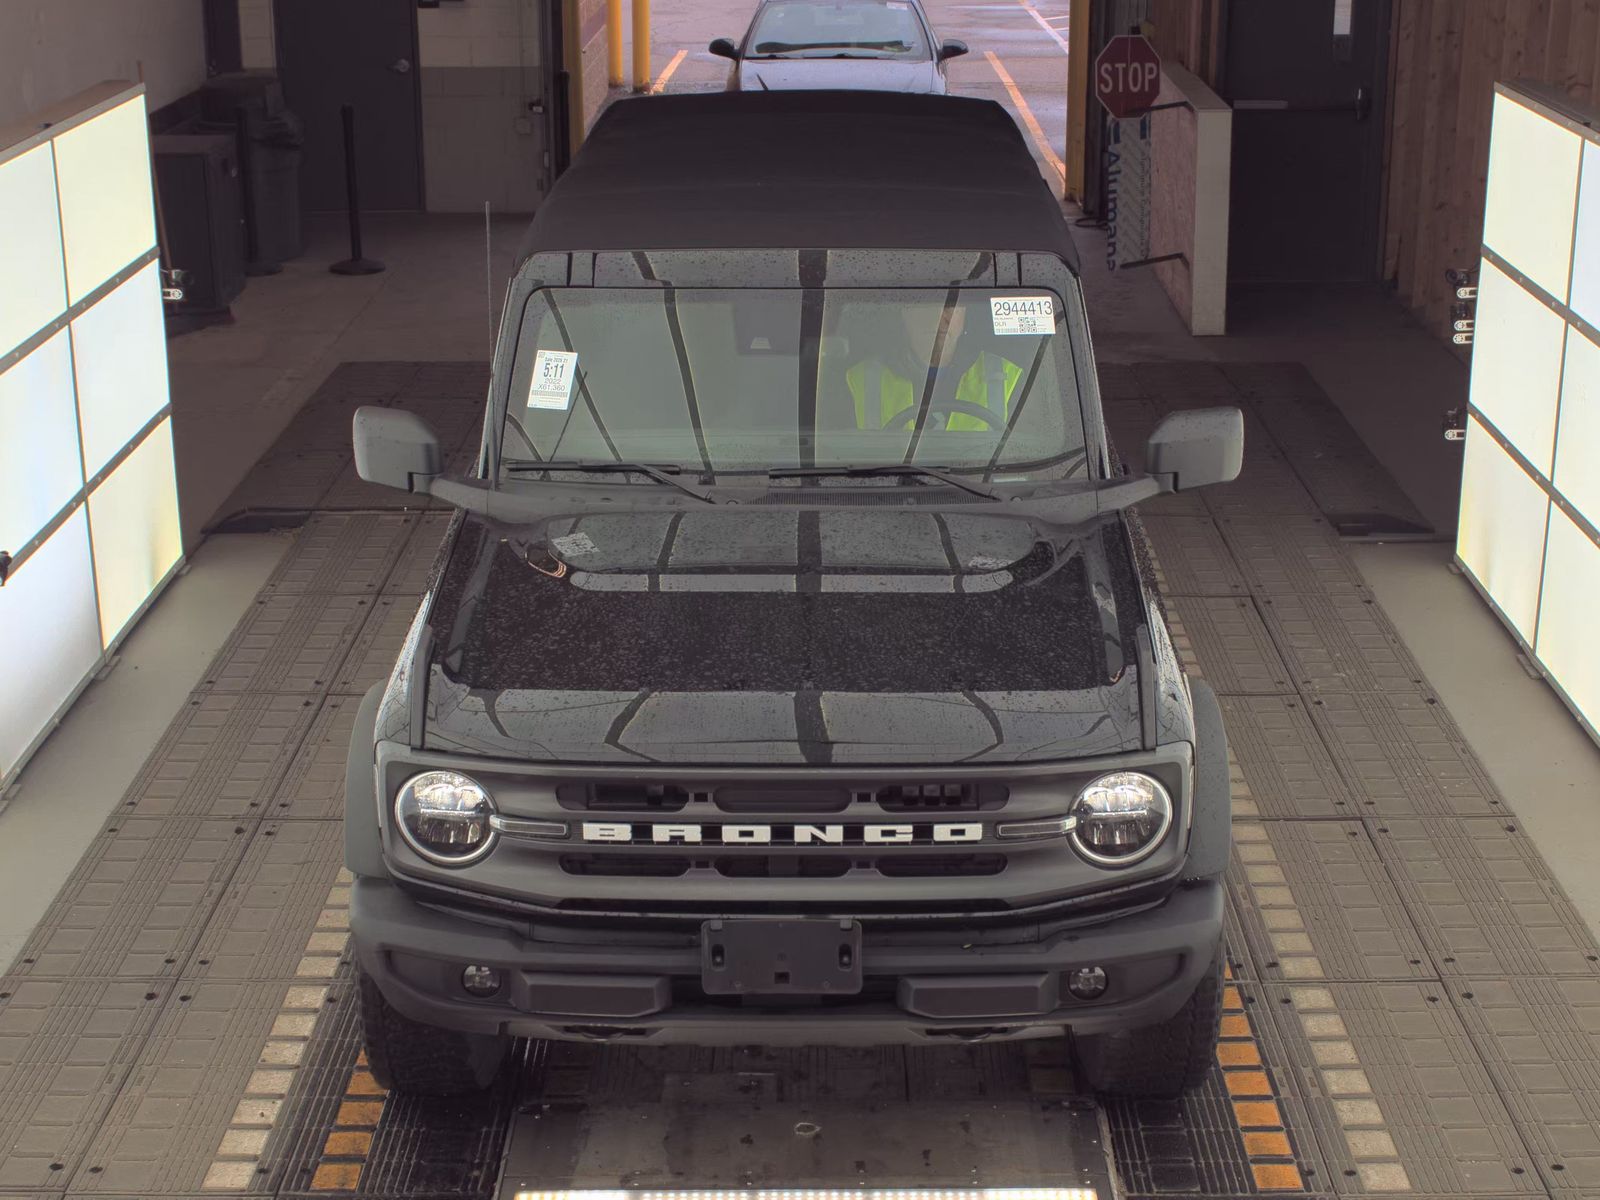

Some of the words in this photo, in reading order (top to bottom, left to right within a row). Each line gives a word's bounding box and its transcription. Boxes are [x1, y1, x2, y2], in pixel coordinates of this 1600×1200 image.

[1100, 62, 1157, 93] STOP
[993, 301, 1053, 316] 2944413
[543, 363, 565, 378] 5:11
[582, 822, 983, 843] BRONCO
